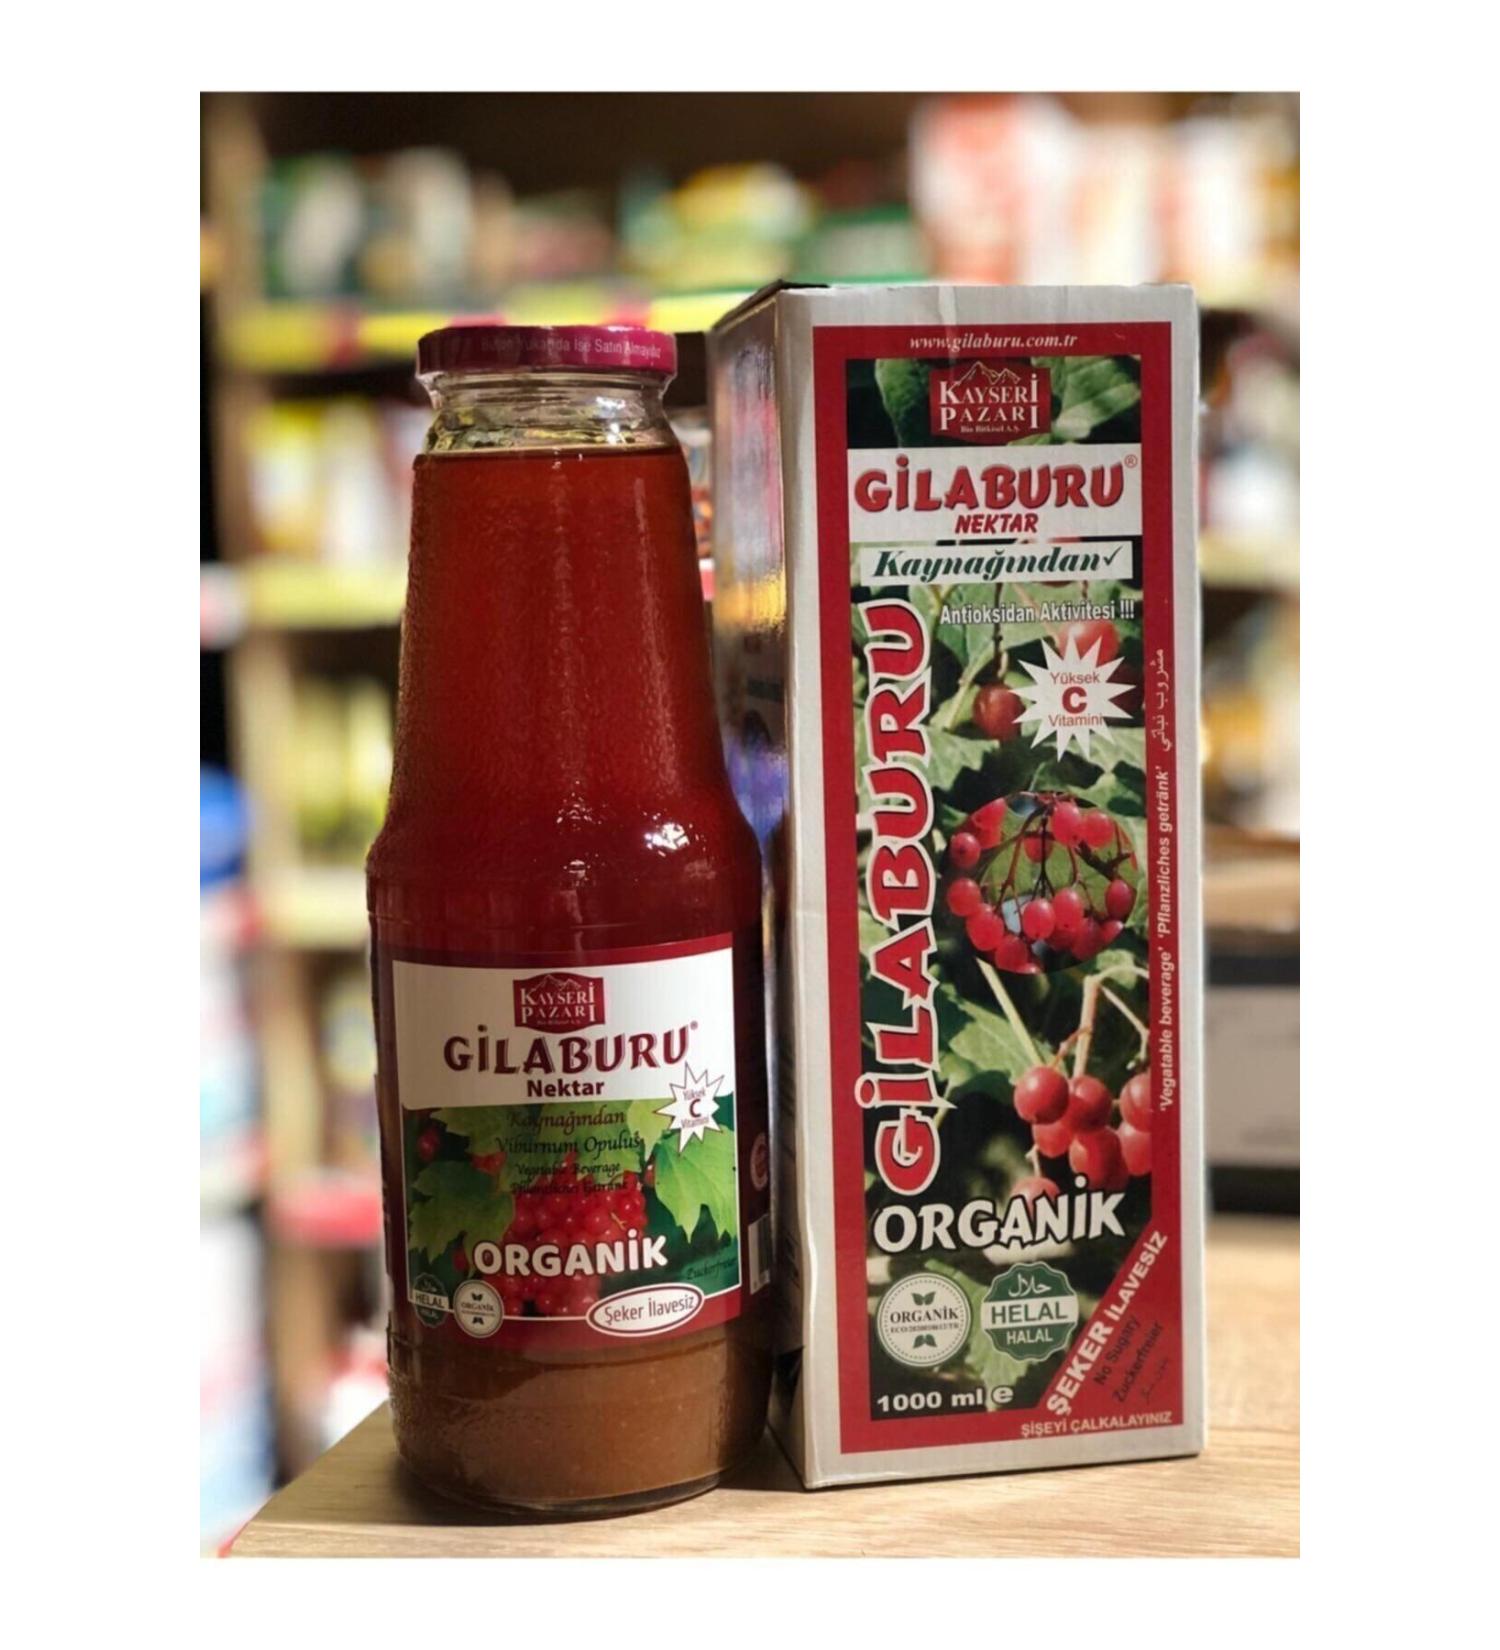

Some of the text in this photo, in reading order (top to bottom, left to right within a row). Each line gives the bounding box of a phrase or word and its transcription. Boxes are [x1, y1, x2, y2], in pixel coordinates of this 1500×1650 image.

[909, 333, 1078, 353] www.gilaburu.com.tr
[939, 374, 1039, 405] KAYSERİ
[940, 403, 1040, 431] PAZARI
[954, 513, 1039, 535] NEKTAR
[872, 546, 1101, 584] Kaynağından
[940, 602, 1035, 625] Antioksidan
[1039, 600, 1115, 622] Aktivitesi
[1050, 671, 1100, 685] Yüksek
[1061, 686, 1088, 714] C
[1049, 713, 1104, 728] Vitamini
[856, 600, 940, 1195] GİLABURU
[521, 1004, 596, 1024] PAZARI
[527, 1079, 605, 1098] Nektar
[689, 1098, 702, 1118] C
[873, 1176, 1125, 1253] ORGANİK
[473, 1229, 668, 1277] ORGANİK
[604, 1294, 695, 1326] Şeker İlavesiz
[890, 1305, 959, 1324] ORGANİK
[991, 1302, 1068, 1324] HELAL
[1047, 1321, 1114, 1416] ŞEKER
[1104, 1230, 1168, 1321] İLAVESİZ
[1006, 1329, 1053, 1345] HALAL
[877, 1391, 942, 1412] 1000
[952, 1388, 983, 1407] ml
[1021, 1412, 1173, 1438] ŞİŞEYİ ÇALKALAYINIZ
